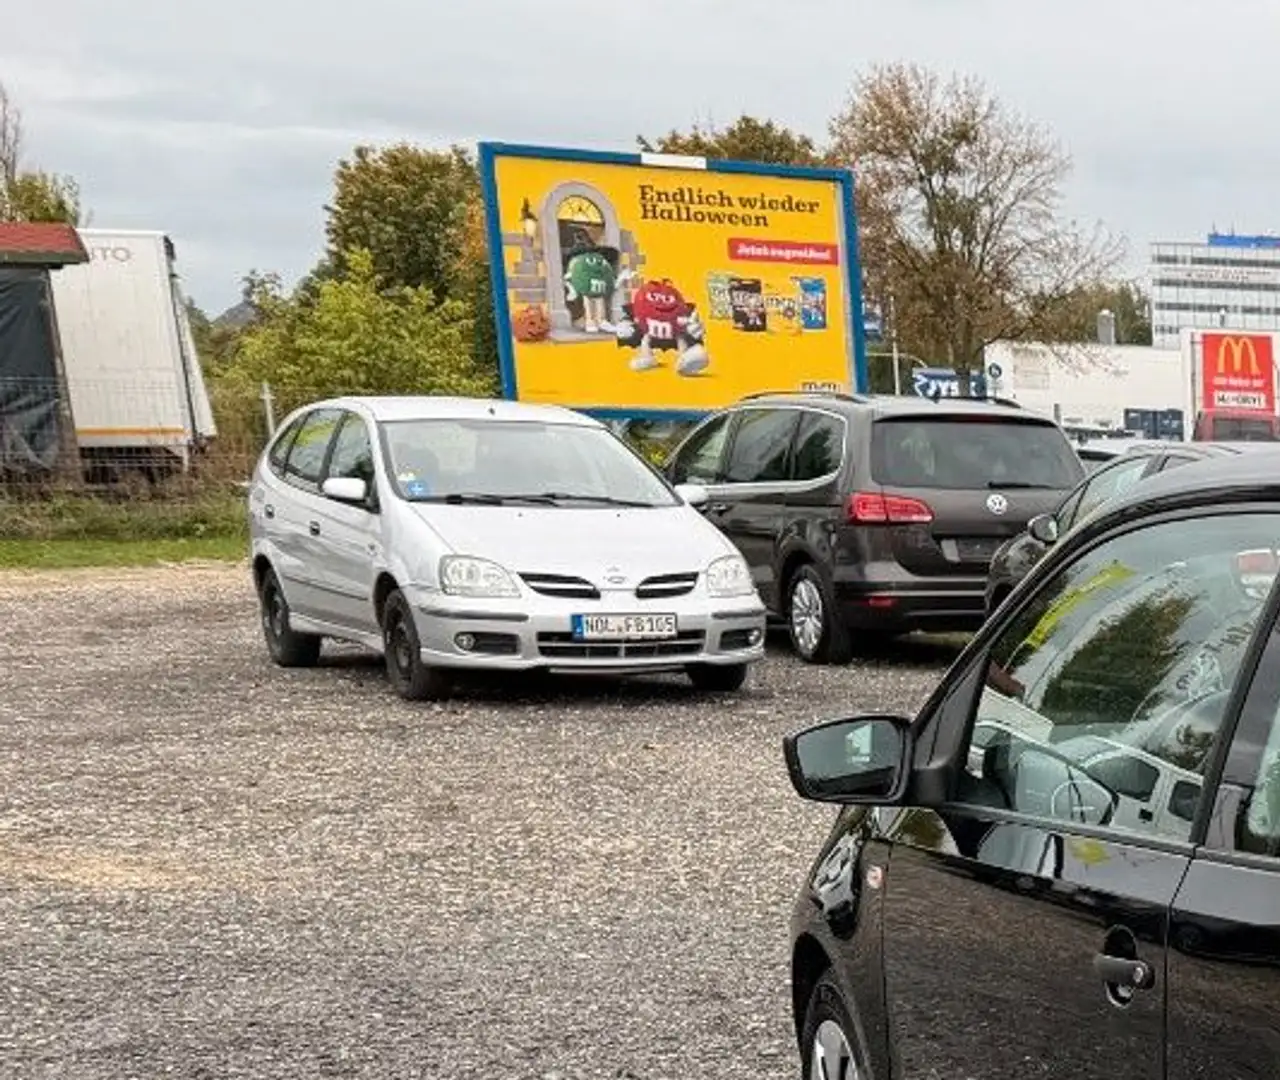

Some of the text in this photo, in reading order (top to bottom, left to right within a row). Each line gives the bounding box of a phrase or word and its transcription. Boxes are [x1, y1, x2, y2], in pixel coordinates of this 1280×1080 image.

[639, 184, 820, 214] Endlich wieder
[641, 203, 769, 227] Halloween
